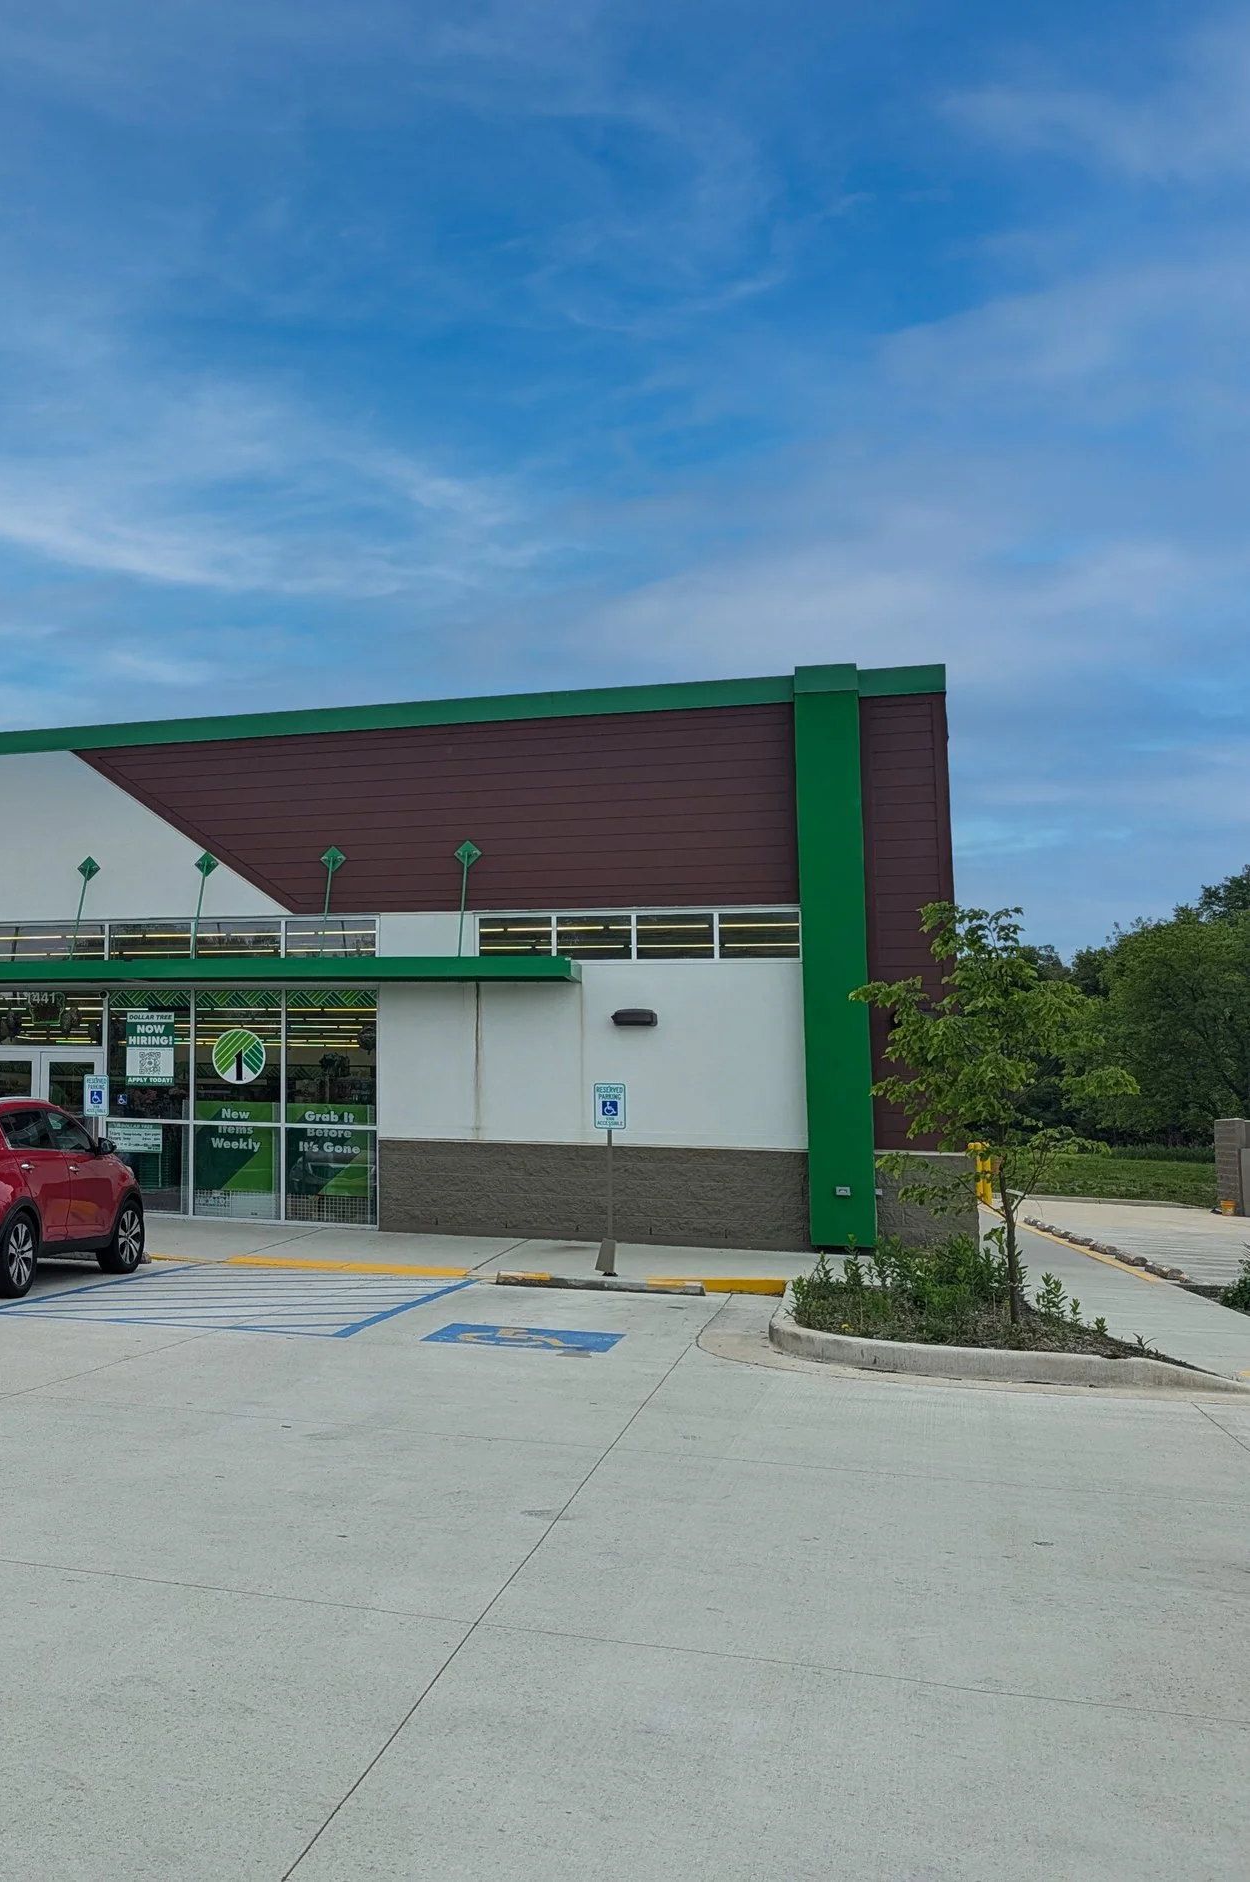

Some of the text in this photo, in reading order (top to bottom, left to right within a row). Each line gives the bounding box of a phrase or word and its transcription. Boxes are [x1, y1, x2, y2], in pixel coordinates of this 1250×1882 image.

[137, 1024, 165, 1034] NOW
[128, 1035, 173, 1045] HIRING!
[221, 1108, 250, 1119] New
[305, 1111, 355, 1123] Grab It
[307, 1128, 352, 1138] Before
[211, 1138, 261, 1152] Weekly
[299, 1142, 361, 1154] It's Gone
